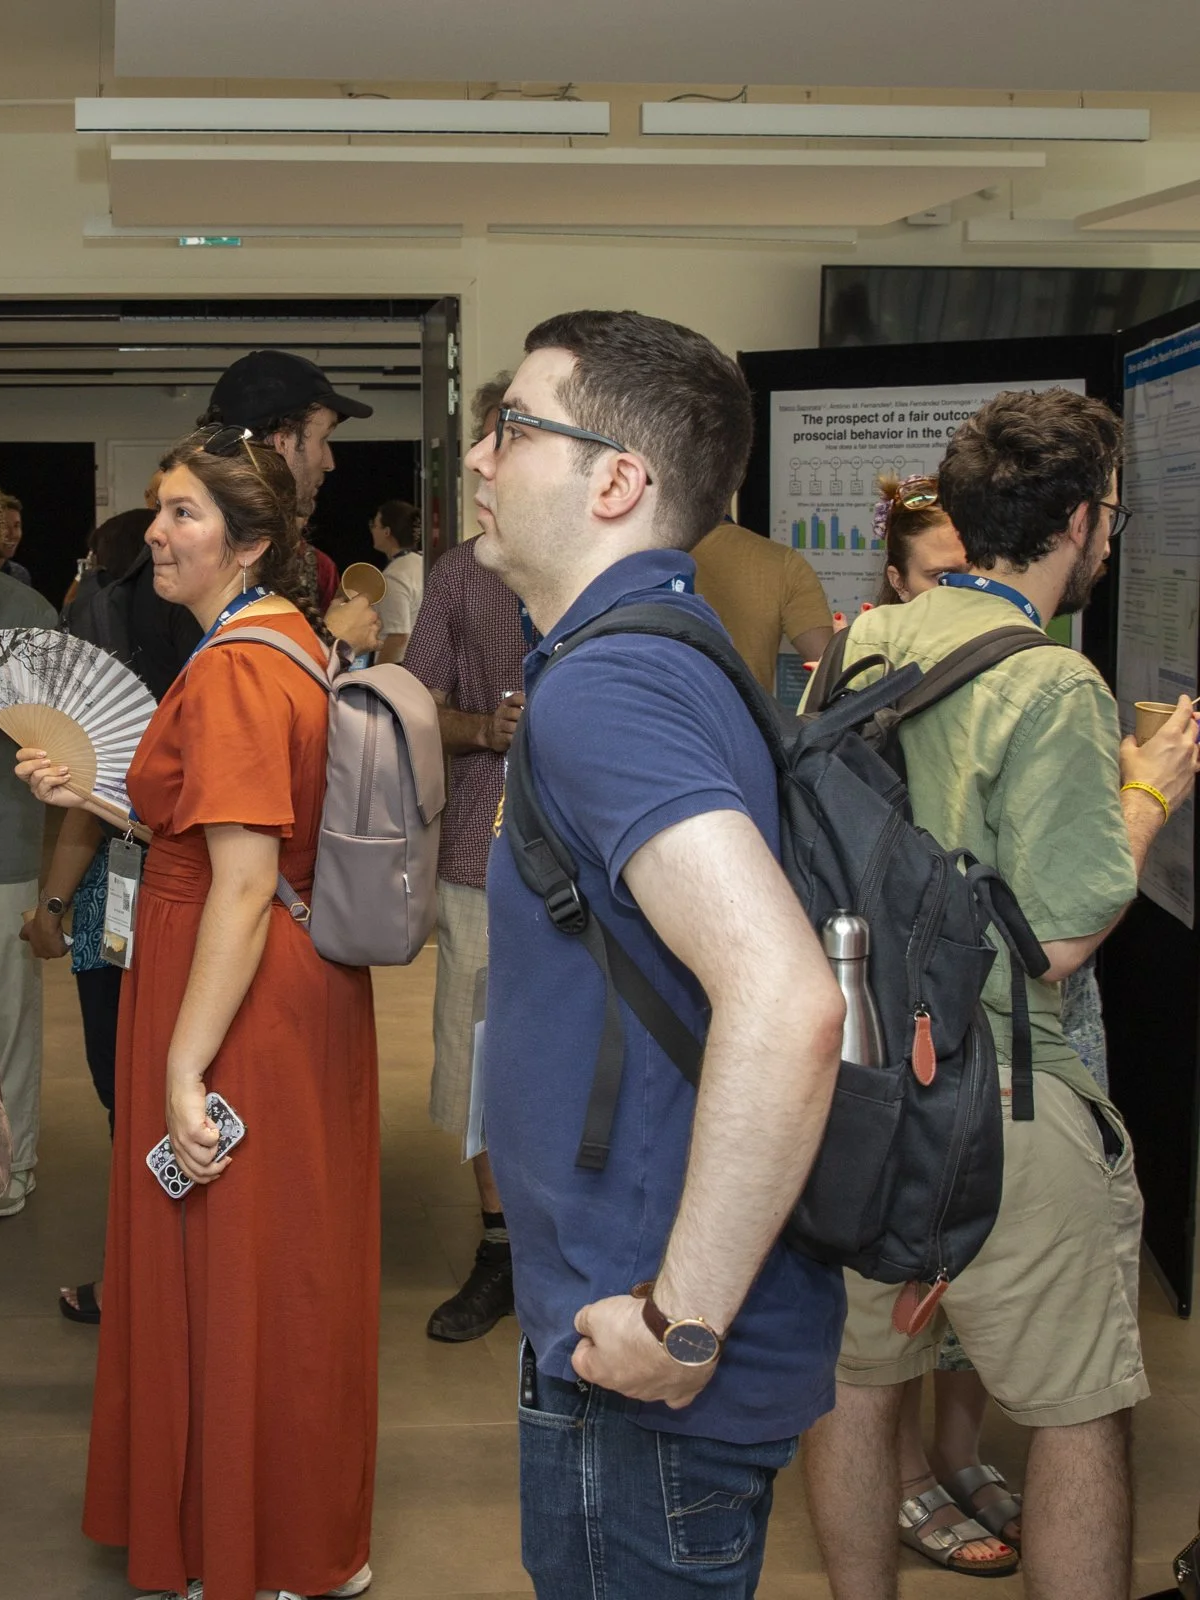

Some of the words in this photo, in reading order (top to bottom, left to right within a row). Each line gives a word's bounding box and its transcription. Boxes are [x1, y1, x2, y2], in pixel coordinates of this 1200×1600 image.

[801, 413, 822, 425] The
[826, 413, 879, 427] prospect
[882, 411, 895, 423] of
[909, 411, 929, 422] fair
[793, 429, 847, 443] prosocial
[851, 428, 903, 440] behavior
[907, 427, 918, 439] in
[922, 427, 941, 438] the
